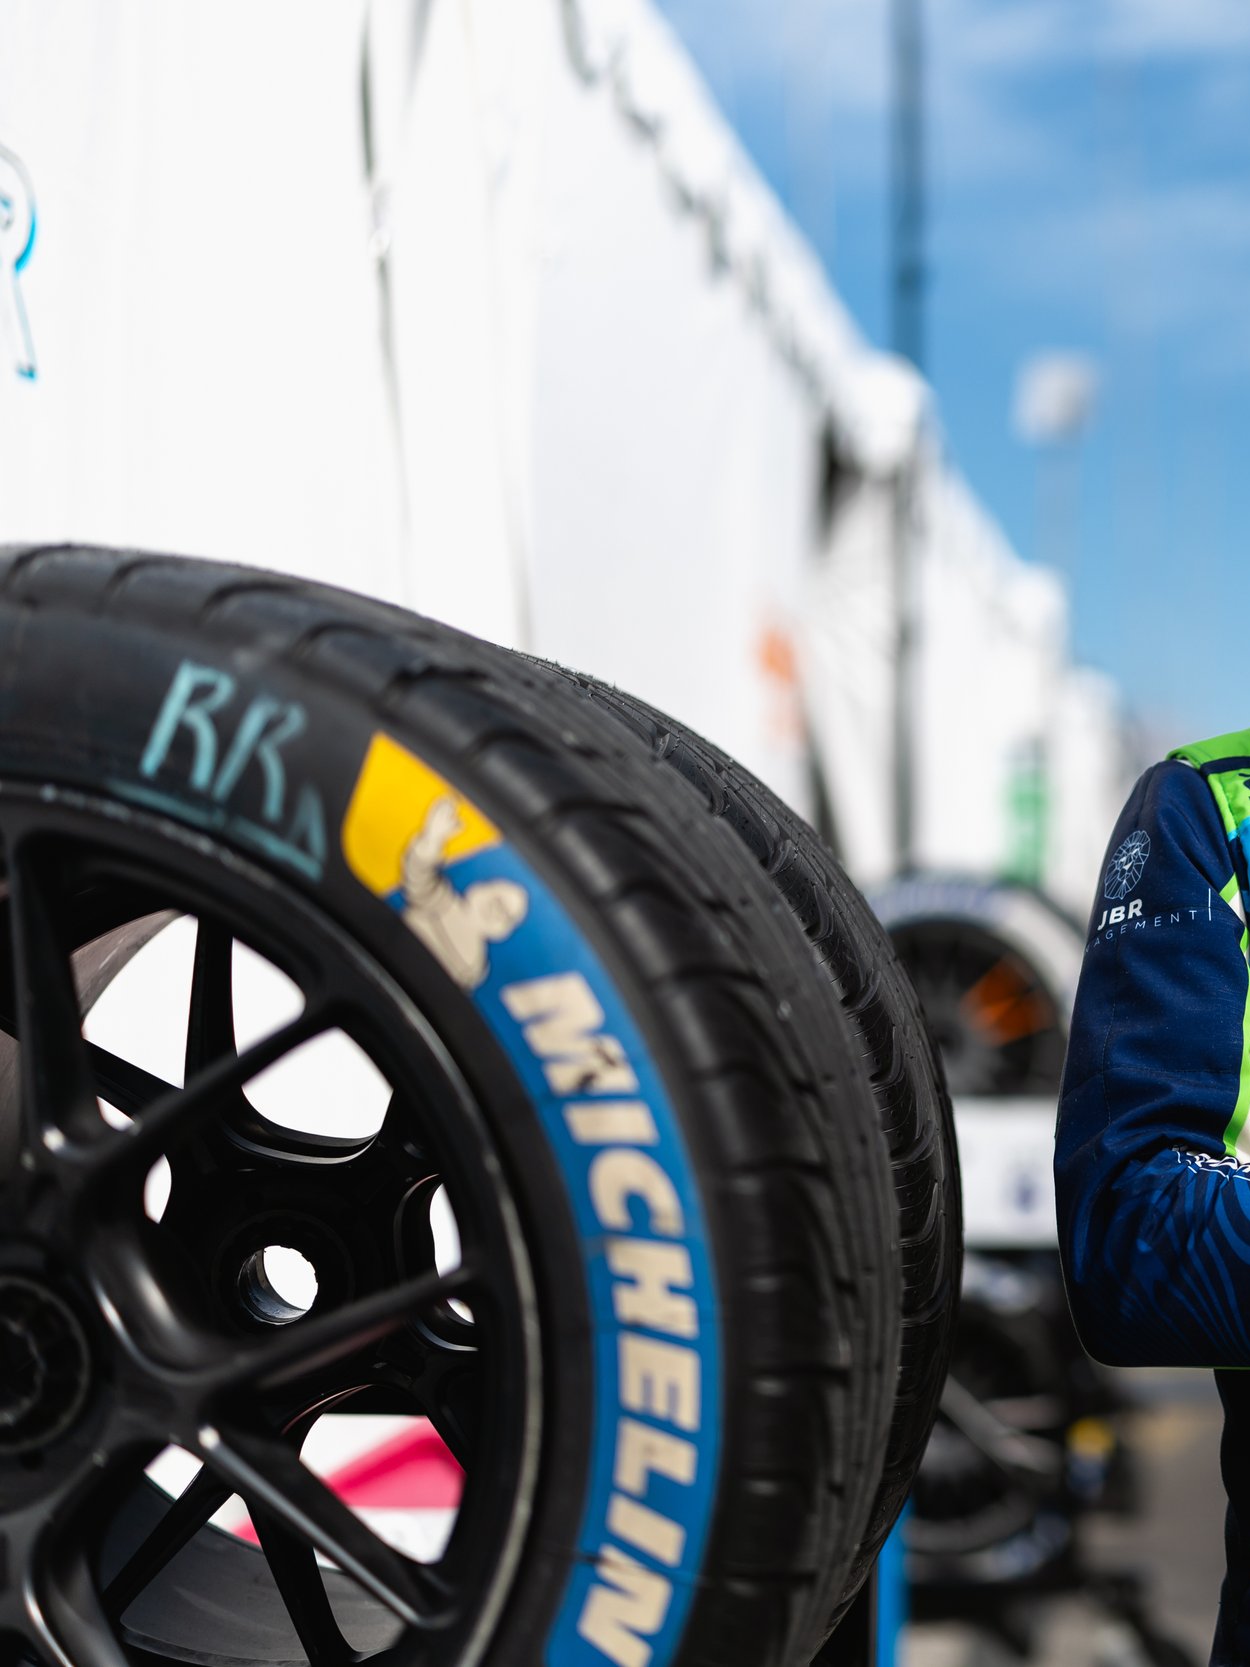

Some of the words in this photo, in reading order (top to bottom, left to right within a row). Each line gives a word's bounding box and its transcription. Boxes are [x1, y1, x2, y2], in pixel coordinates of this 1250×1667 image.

[1085, 909, 1198, 953] AGEMENT
[1097, 898, 1143, 931] JBR
[501, 969, 703, 1667] MICHELIN
